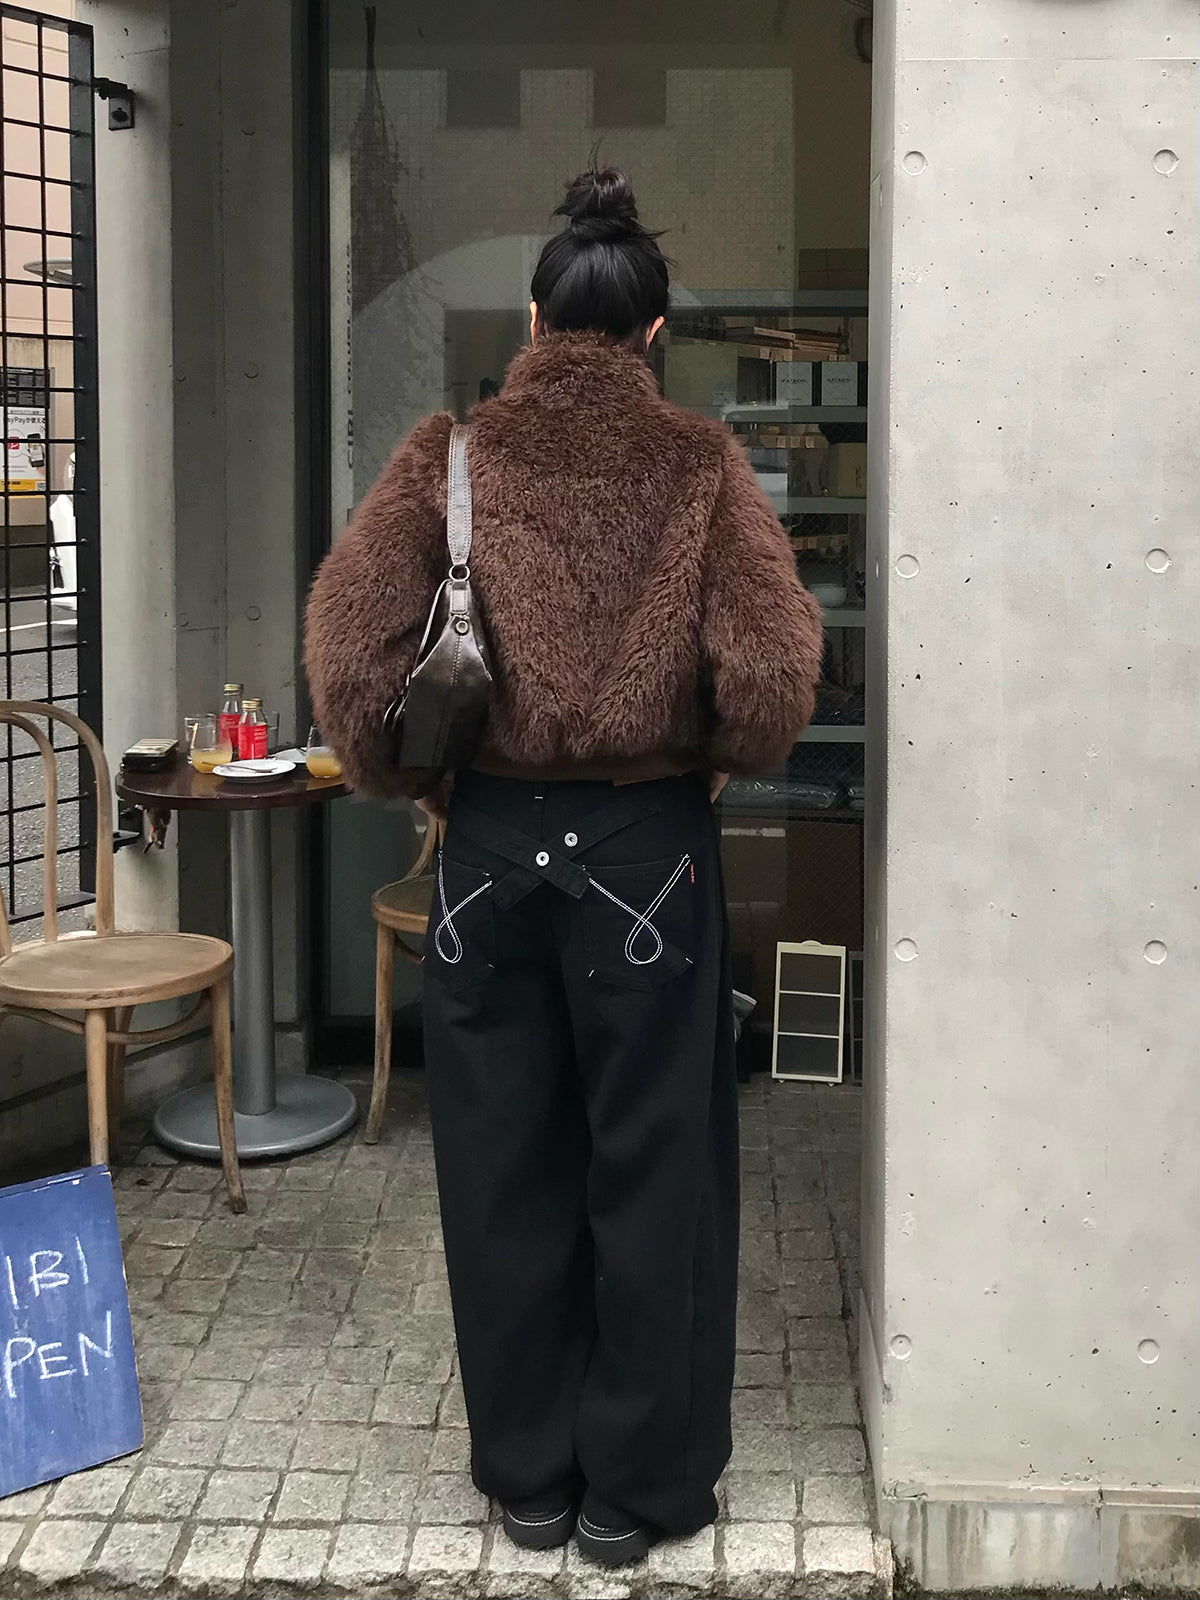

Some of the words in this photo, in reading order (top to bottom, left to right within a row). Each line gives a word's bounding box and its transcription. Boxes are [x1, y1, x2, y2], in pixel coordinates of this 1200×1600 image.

[7, 416, 46, 425] ayPayが使える
[0, 1310, 113, 1399] PEN
